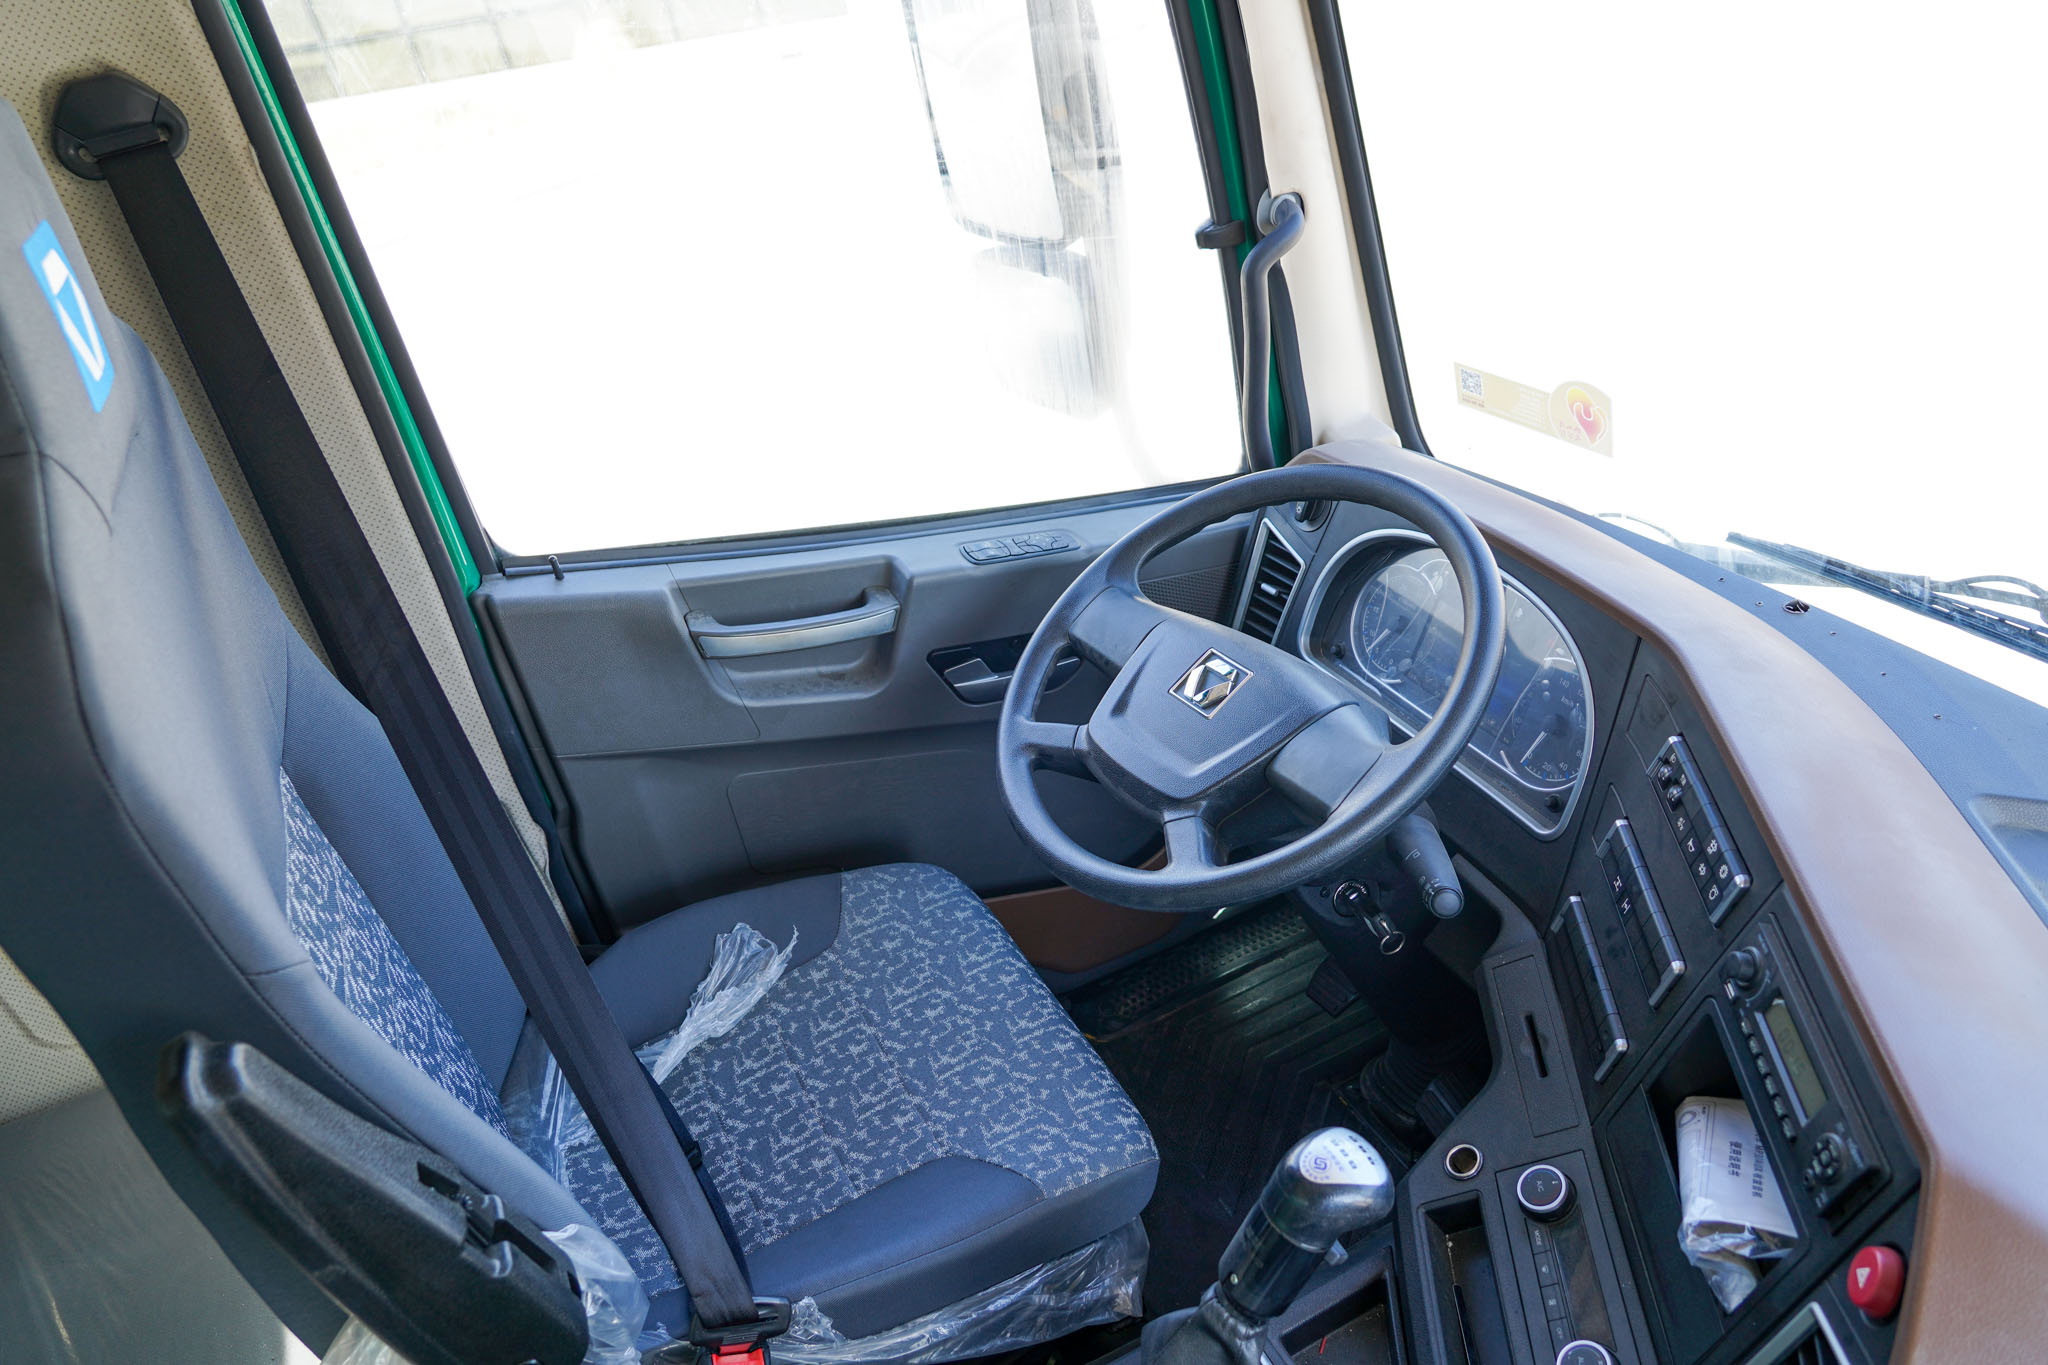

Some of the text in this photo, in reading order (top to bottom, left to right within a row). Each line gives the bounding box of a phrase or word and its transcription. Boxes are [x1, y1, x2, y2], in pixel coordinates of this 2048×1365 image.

[1560, 677, 1570, 688] 140
[1542, 761, 1551, 771] 20
[1559, 761, 1568, 771] 40
[1534, 1229, 1542, 1246] MODE
[1556, 1327, 1564, 1339] OFF
